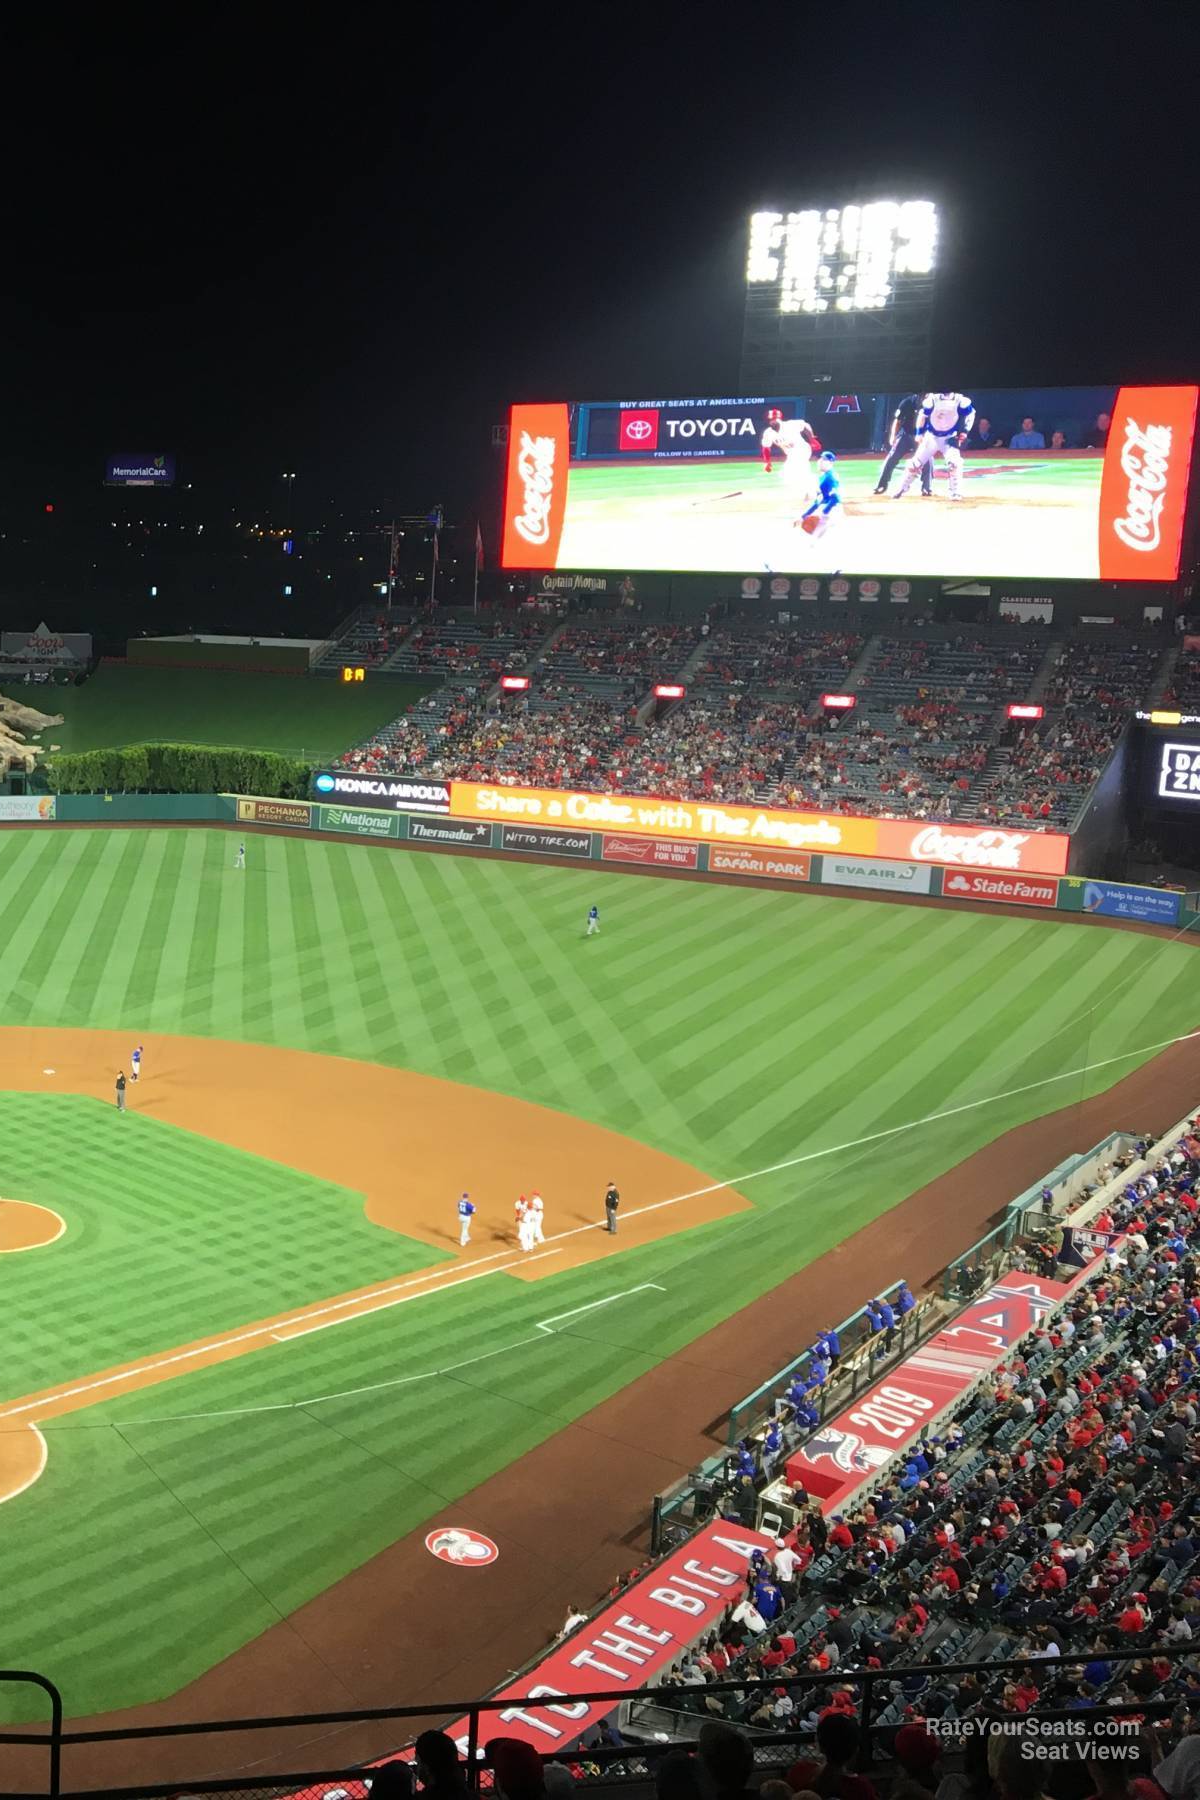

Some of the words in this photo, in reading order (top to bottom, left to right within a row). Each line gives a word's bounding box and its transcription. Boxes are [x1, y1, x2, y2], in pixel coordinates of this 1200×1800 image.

[666, 418, 756, 438] TOYOTA
[113, 467, 166, 476] MemorialCare
[543, 575, 572, 590] Captain
[573, 576, 606, 591] Morgan
[1136, 711, 1151, 719] the
[335, 778, 388, 796] KONICA
[389, 783, 449, 801] MINOLTA
[258, 805, 308, 817] PECHANGA
[341, 812, 392, 827] National
[477, 790, 541, 815] Share
[547, 801, 562, 817] a
[566, 794, 634, 823] Coke
[637, 806, 692, 829] with
[697, 808, 750, 836] The
[750, 815, 841, 846] Angels
[412, 823, 475, 841] Thermador
[506, 832, 536, 844] NITTO
[540, 834, 588, 850] TIRE.COM
[655, 843, 672, 851] THIS
[673, 844, 696, 854] BUD'S
[654, 852, 669, 860] FOR
[671, 853, 687, 862] YOU.
[714, 857, 763, 871] SAFARI
[766, 863, 804, 876] PARK
[835, 865, 867, 876] EVA
[868, 869, 896, 878] AIR
[1106, 891, 1125, 900] Help
[1145, 896, 1157, 904] the
[1158, 900, 1174, 908] way.
[850, 1386, 934, 1439] 2019
[570, 1614, 674, 1682] THE
[649, 1559, 741, 1617] BIG
[711, 1534, 769, 1560] A
